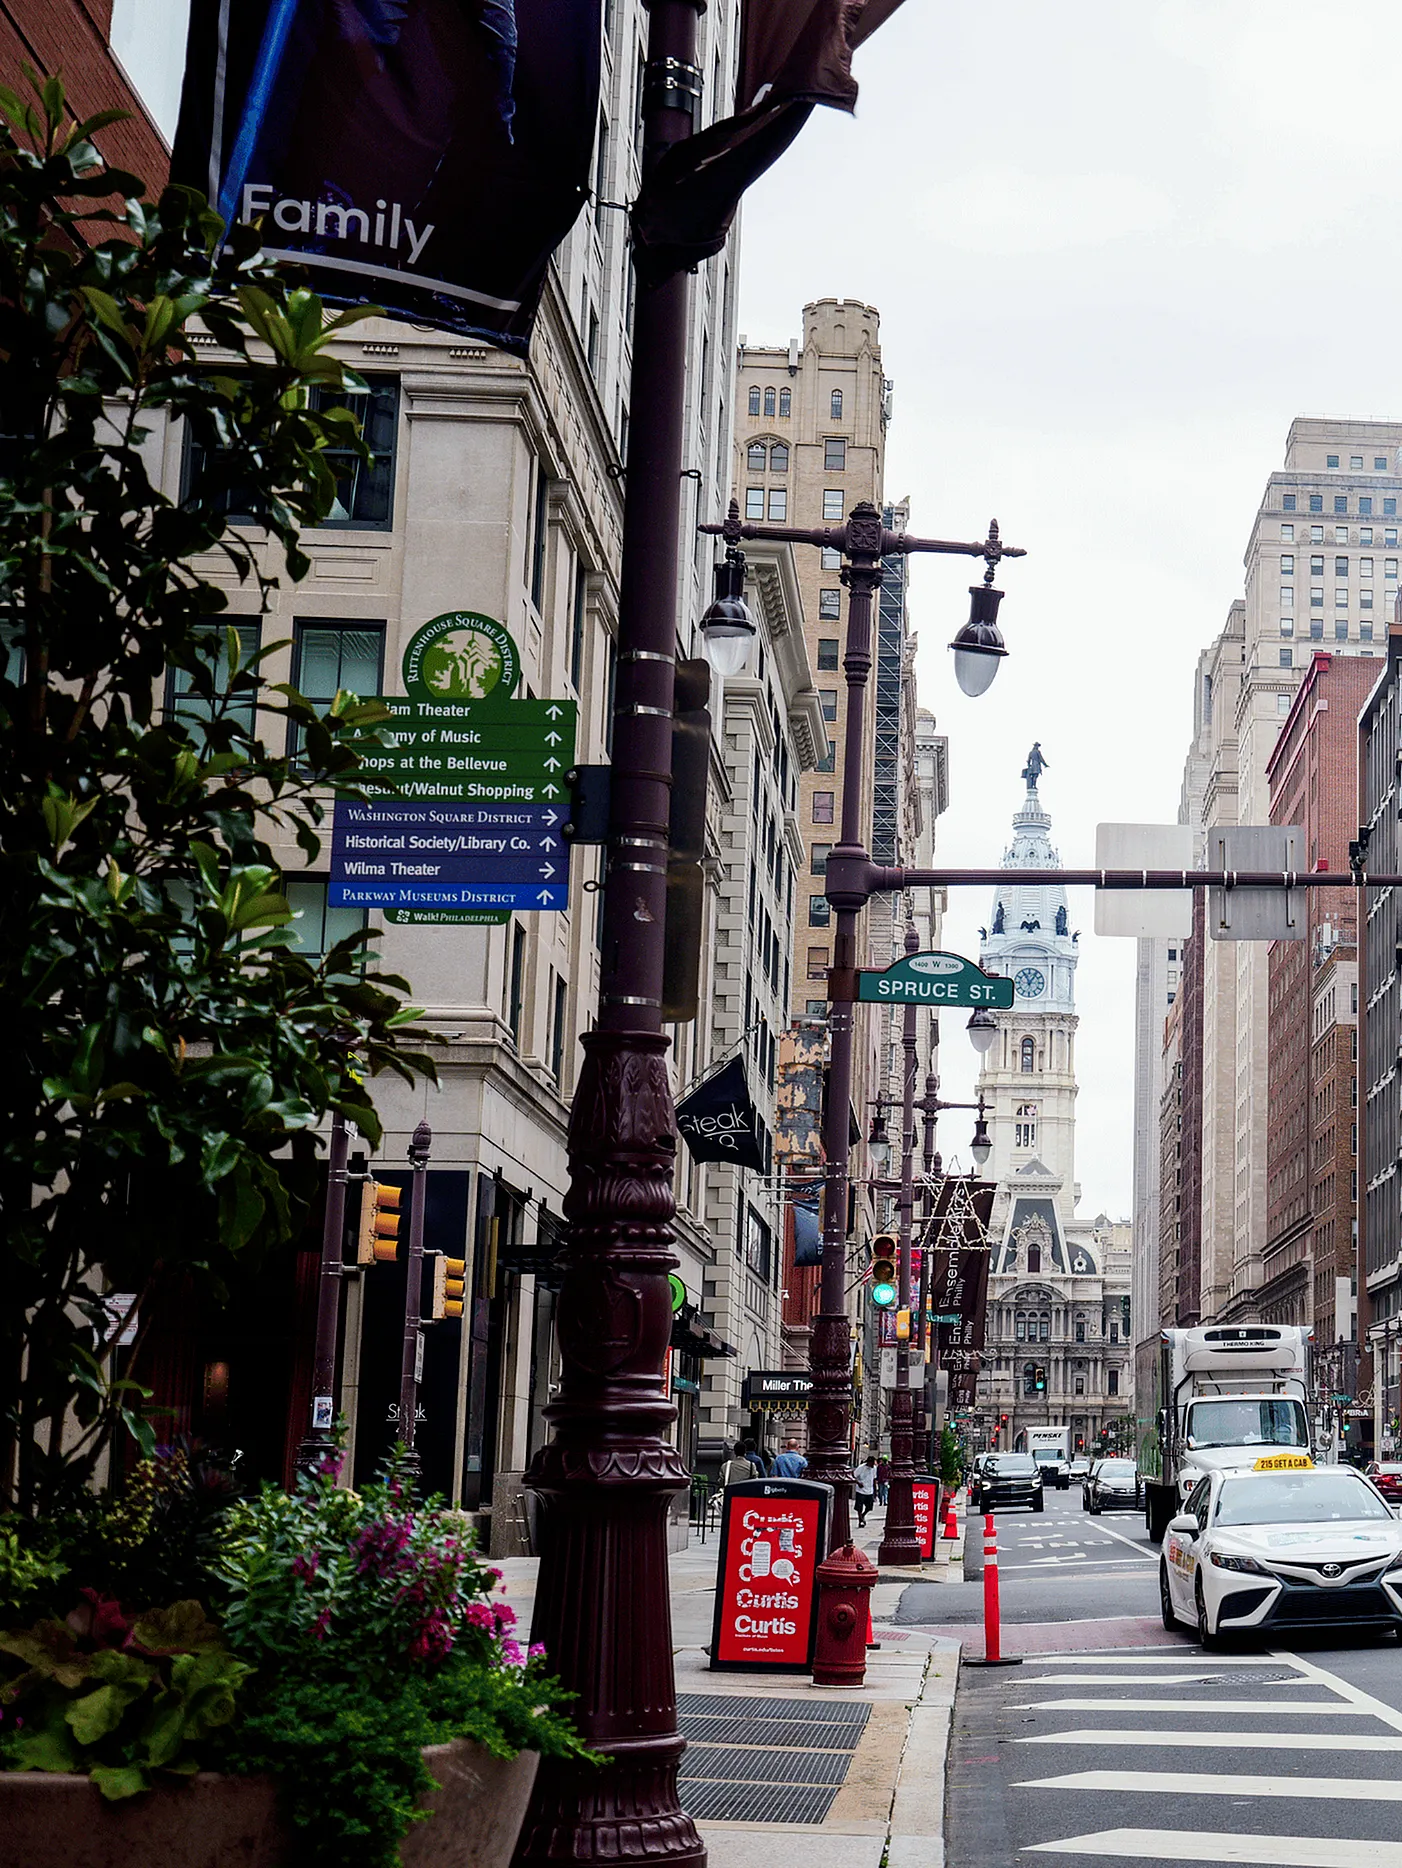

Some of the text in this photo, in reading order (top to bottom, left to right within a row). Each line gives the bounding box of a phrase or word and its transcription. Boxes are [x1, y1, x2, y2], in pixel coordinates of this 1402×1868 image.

[240, 182, 436, 264] Family
[455, 614, 498, 637] SQUARE
[407, 618, 454, 683] RITTENHOUSE
[495, 633, 513, 685] DISTRICT
[416, 703, 470, 717] Theater
[421, 729, 437, 742] of
[440, 729, 481, 743] Music
[358, 754, 507, 771] hops at the Bellevue
[467, 783, 535, 800] Shopping
[348, 809, 533, 824] WASHINGTON SQUARE DISTRICT
[345, 835, 531, 852] Historical Society/Library Co.
[344, 862, 441, 876] Wilma Theater
[342, 889, 516, 903] PARKWAY MUSEUMS DISTRICT
[932, 960, 941, 968] W
[878, 979, 996, 1000] SPRUCE ST.
[678, 1103, 749, 1135] Steak
[953, 1278, 966, 1307] Philly
[964, 1320, 975, 1345] Philly
[762, 1379, 792, 1391] Miller
[1261, 1459, 1308, 1468] 215 GET A CAB
[736, 1588, 799, 1609] Curtis
[734, 1614, 797, 1635] Curtis
